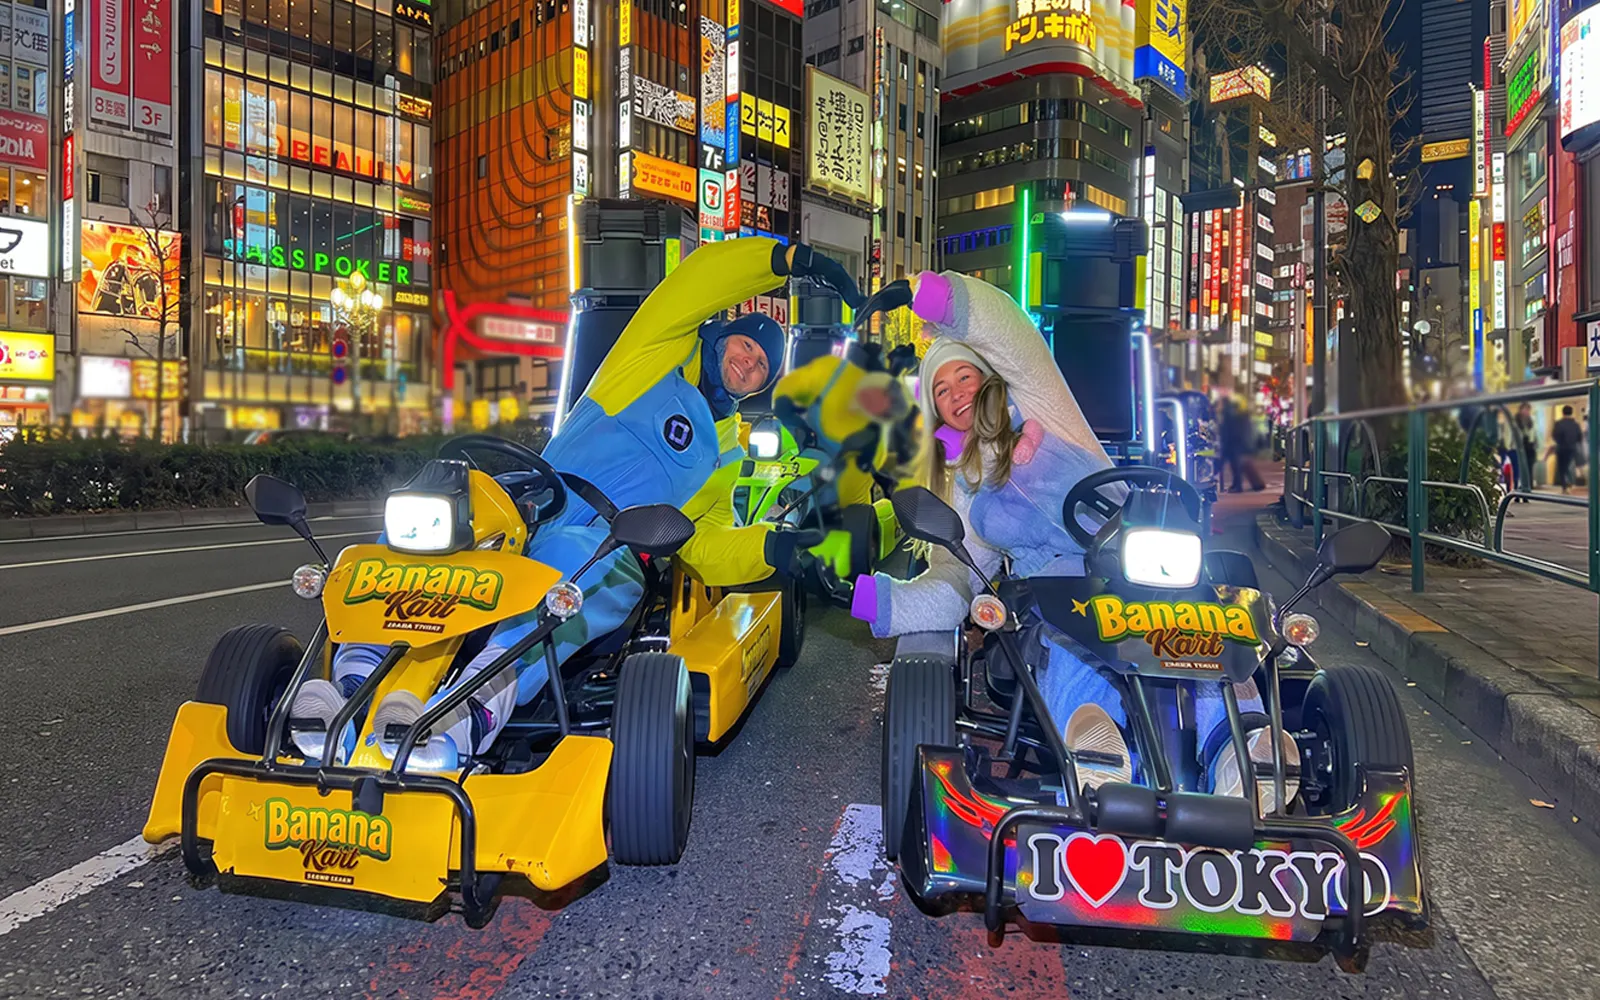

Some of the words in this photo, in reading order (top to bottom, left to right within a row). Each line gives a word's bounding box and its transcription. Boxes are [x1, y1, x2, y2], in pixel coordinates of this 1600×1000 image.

[702, 144, 723, 170] 7F
[344, 558, 503, 611] Banana
[384, 589, 460, 620] Kart
[1090, 594, 1261, 647] Banana
[1144, 626, 1224, 659] Kart
[265, 797, 392, 862] Banana
[300, 838, 360, 871] Kart
[1028, 832, 1065, 901] I
[1129, 840, 1391, 921] TOKYO
